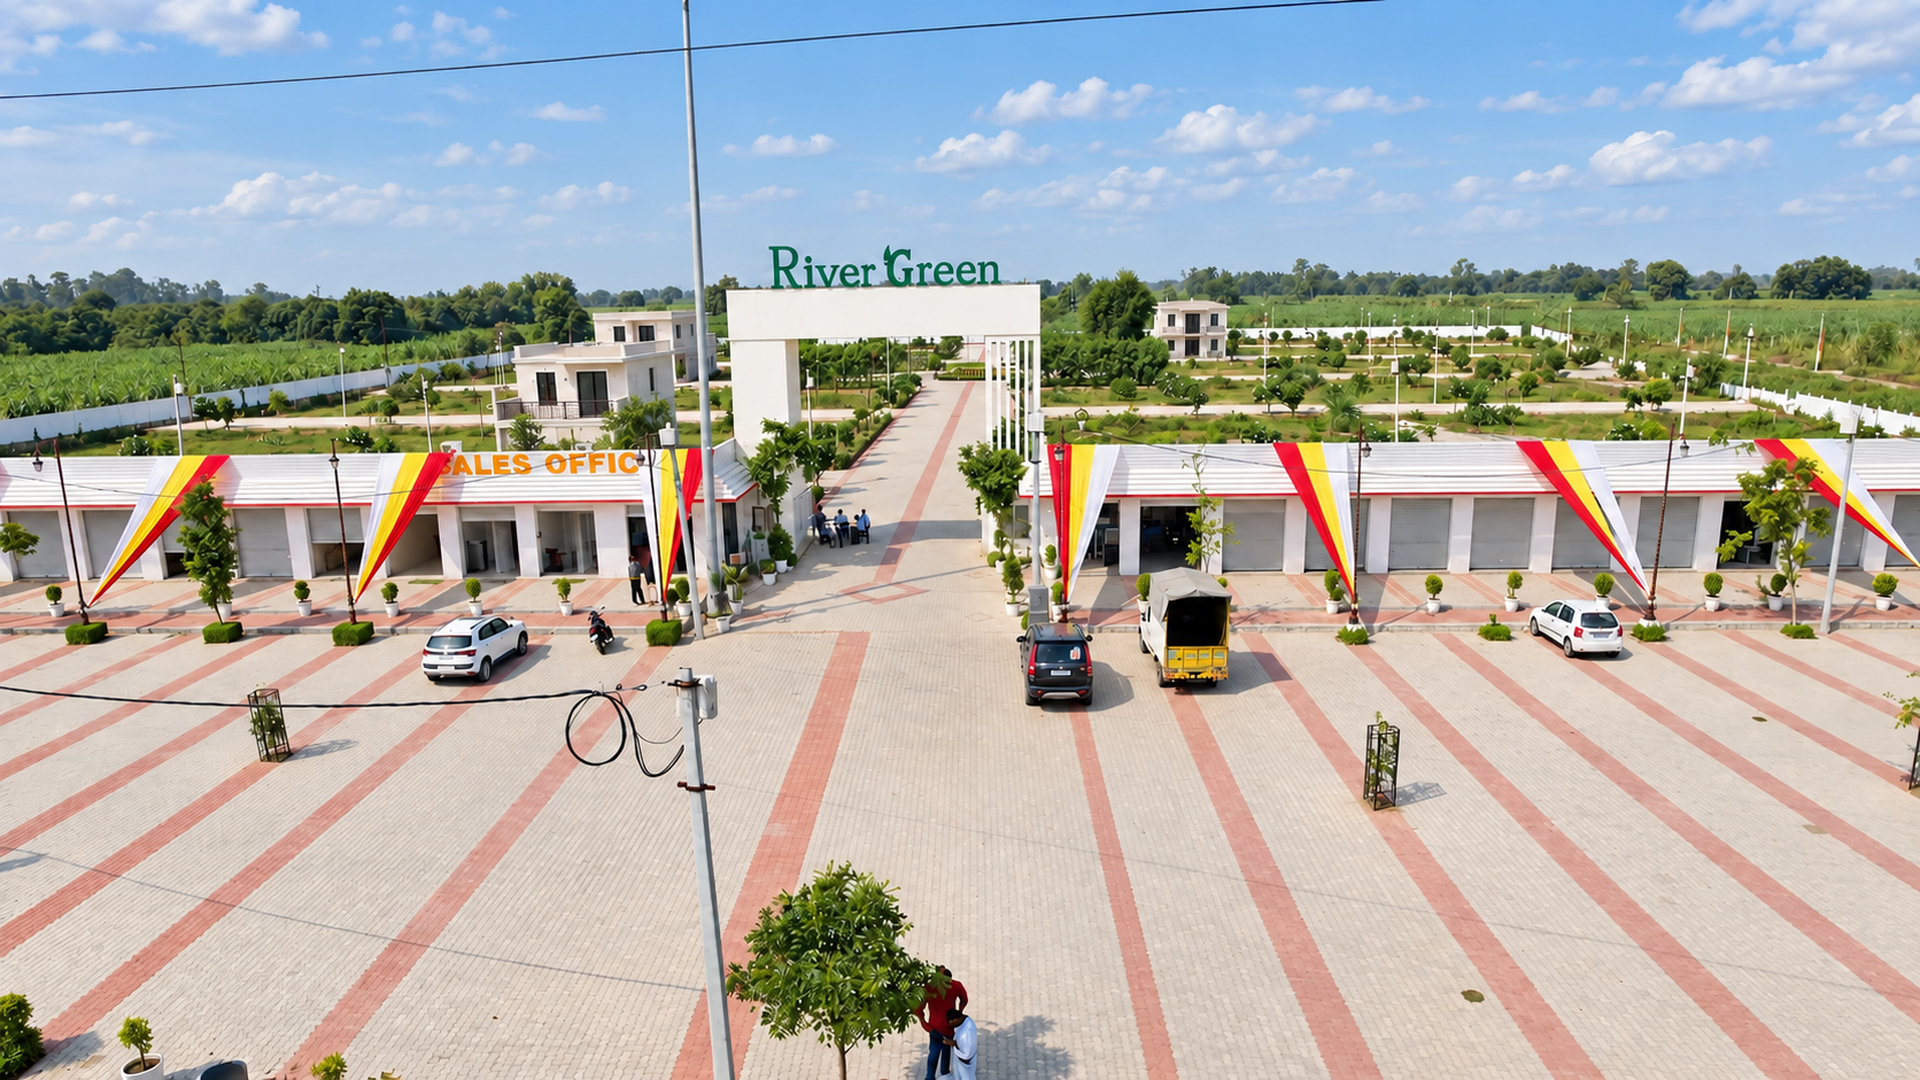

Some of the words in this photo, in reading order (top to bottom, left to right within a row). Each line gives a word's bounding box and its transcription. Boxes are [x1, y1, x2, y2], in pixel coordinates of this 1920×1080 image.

[768, 245, 876, 289] River
[885, 246, 1001, 287] Green
[545, 452, 639, 474] OFFIC
